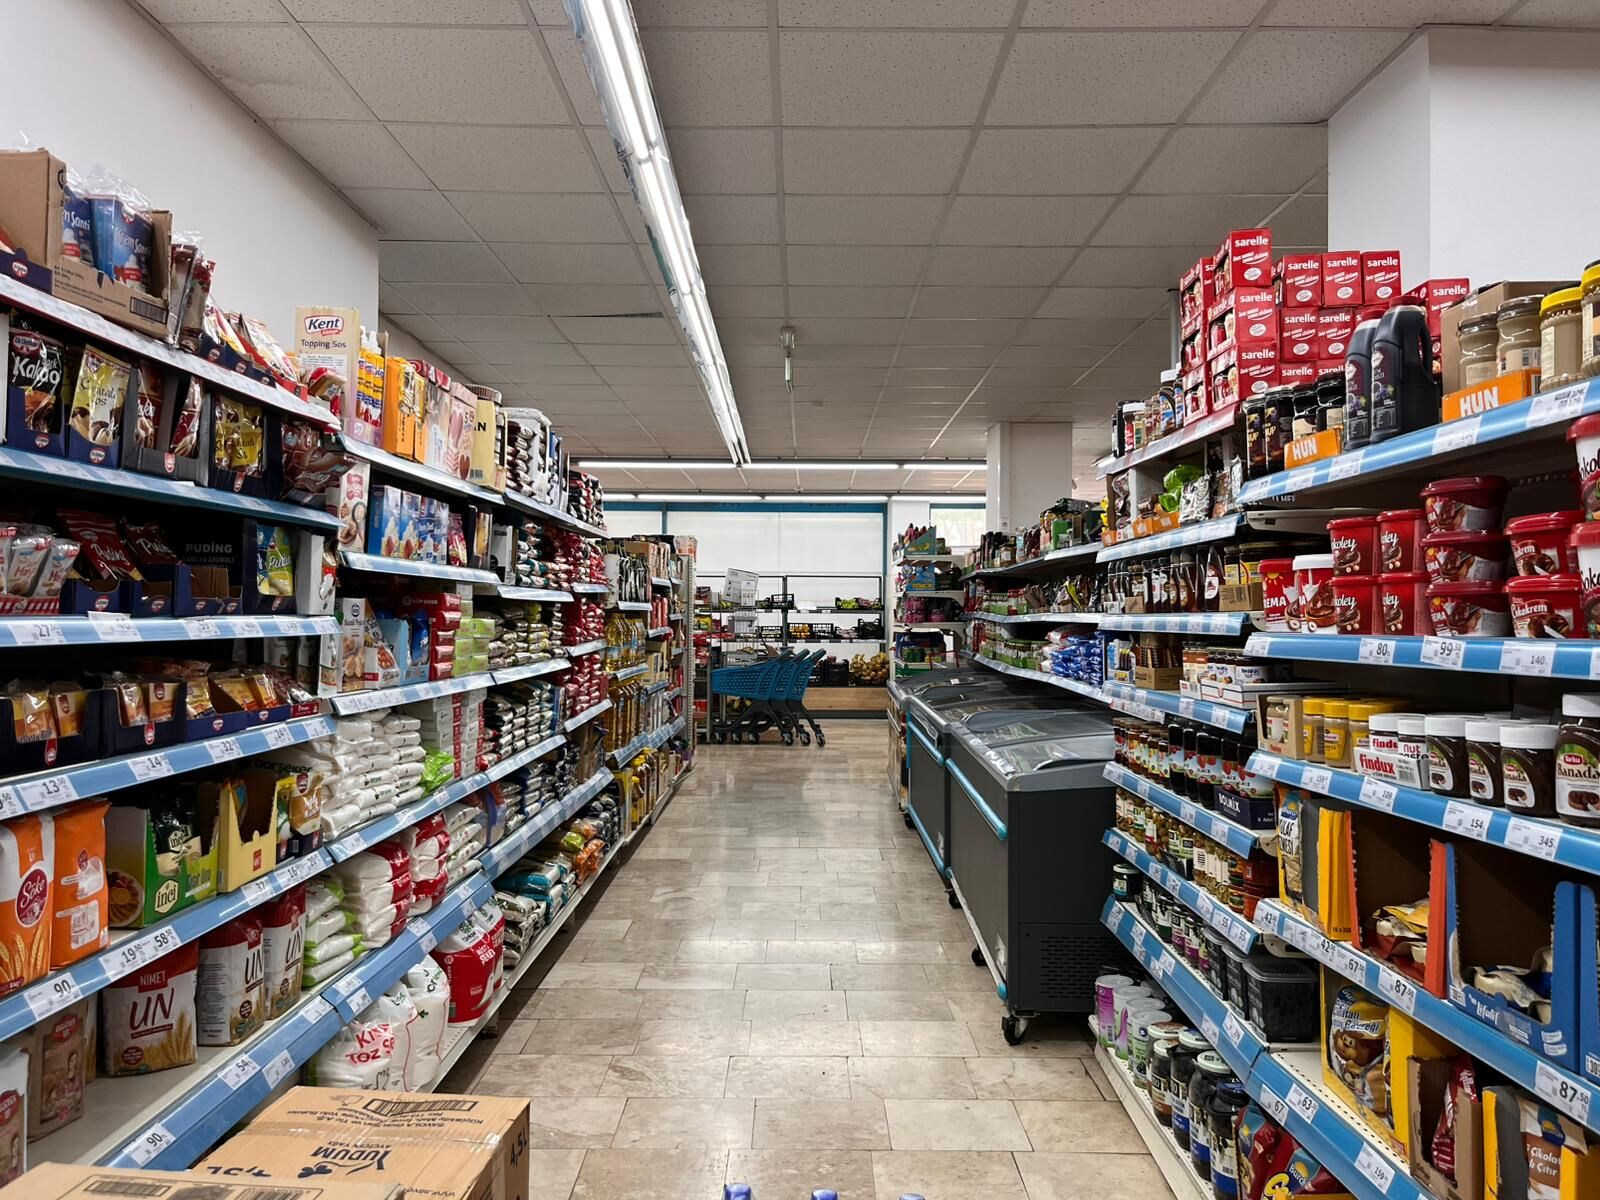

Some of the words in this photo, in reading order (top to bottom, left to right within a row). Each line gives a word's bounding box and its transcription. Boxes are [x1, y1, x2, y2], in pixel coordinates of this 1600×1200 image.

[1234, 235, 1269, 247] sarelle
[1288, 260, 1319, 270] sarelle
[1327, 257, 1358, 267] sarelle
[1367, 257, 1398, 267] sarelle
[1433, 286, 1467, 296] sarelle
[1239, 293, 1272, 303] sarelle
[308, 318, 340, 331] Kent
[1284, 314, 1316, 324] sarelle
[1319, 313, 1350, 324] sarelle
[301, 339, 330, 349] Topping
[332, 340, 346, 349] Sos
[1241, 350, 1274, 360] sarelle
[1282, 366, 1312, 377] sarelle
[1459, 386, 1499, 418] HUN
[1292, 437, 1317, 461] HUN
[185, 541, 233, 554] PUDİNG
[1376, 643, 1388, 656] 80
[1470, 818, 1483, 829] 154
[1538, 836, 1554, 848] 345
[21, 877, 45, 908] Söke
[156, 884, 178, 908] inci
[140, 970, 166, 986] NİMET
[54, 979, 71, 997] 90
[129, 987, 175, 1031] UN
[345, 1048, 381, 1064] TOZ
[147, 1131, 163, 1147] 90
